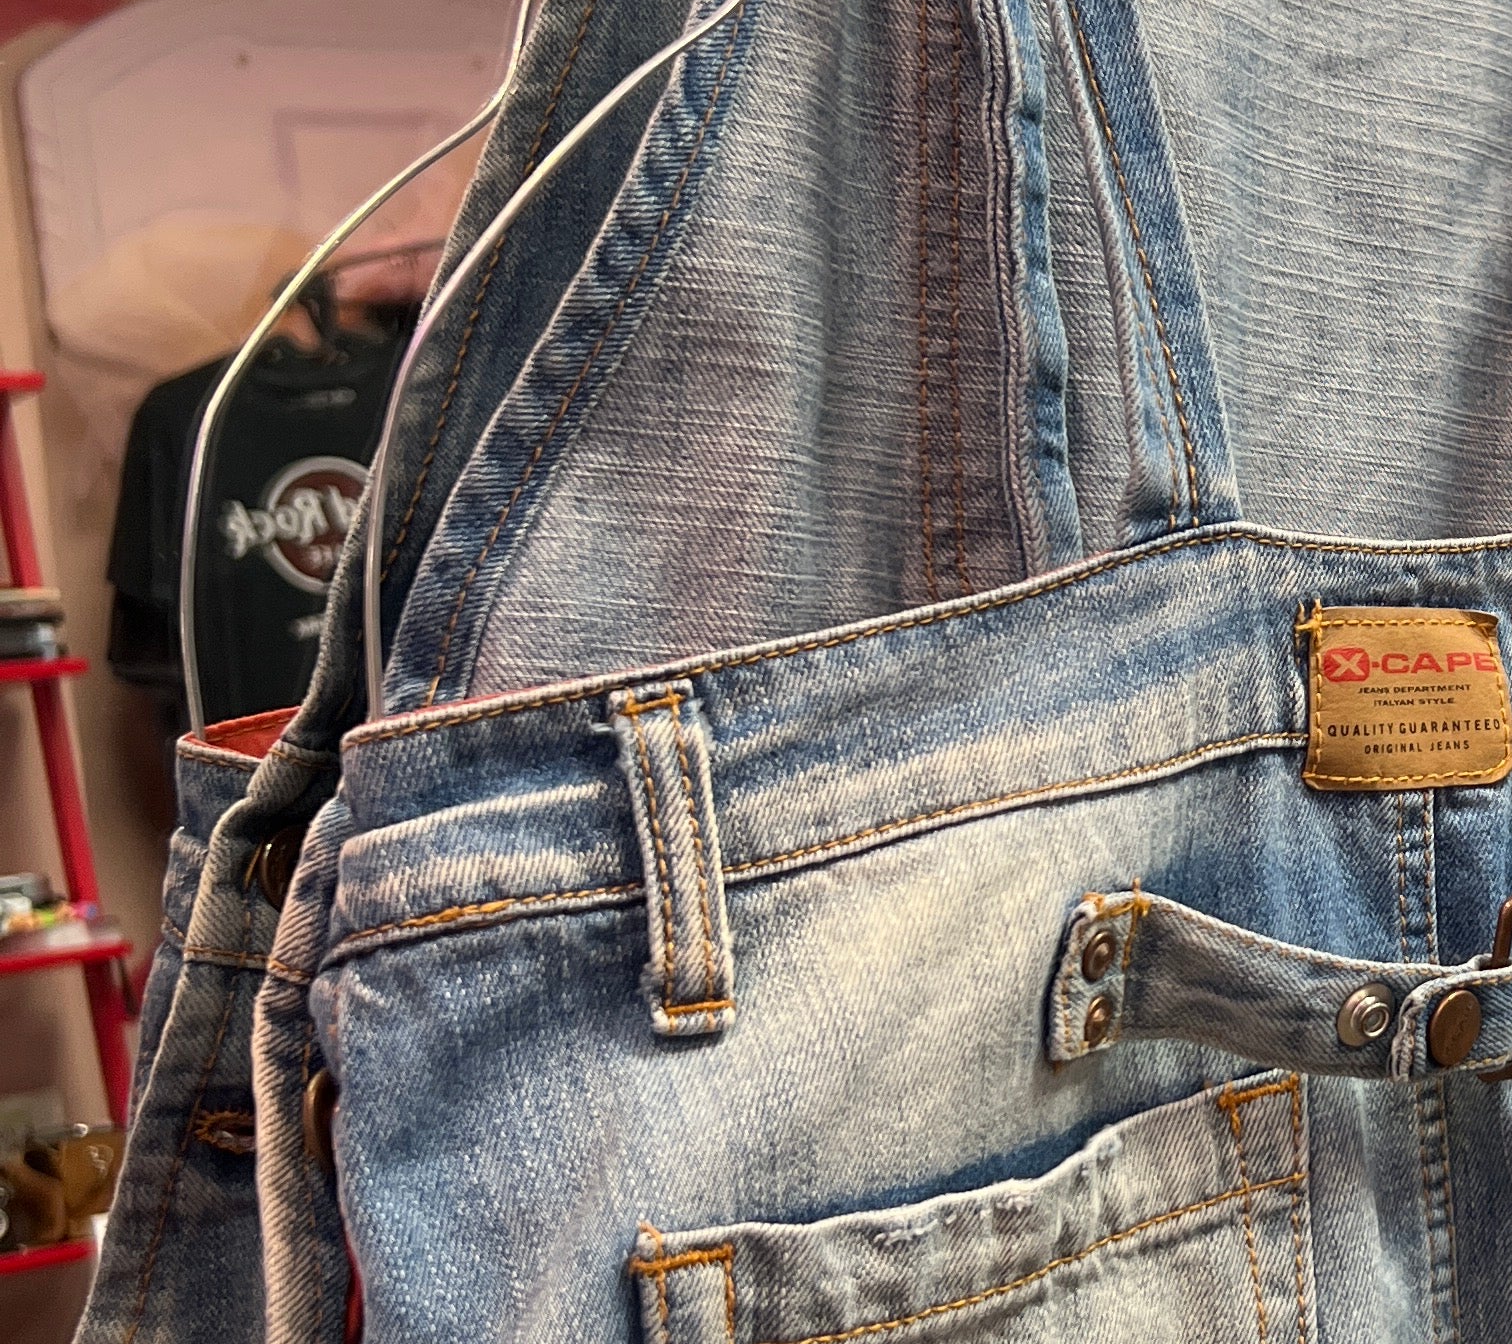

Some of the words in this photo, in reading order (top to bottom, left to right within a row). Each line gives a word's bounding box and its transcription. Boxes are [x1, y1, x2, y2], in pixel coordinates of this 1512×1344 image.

[1322, 646, 1498, 683] X-CAPE
[1358, 685, 1390, 694] JEANS
[1393, 683, 1471, 694] DEPARTMENT
[1418, 697, 1455, 706] STYLE
[1327, 722, 1394, 738] QUALITY
[1399, 718, 1501, 735] GUARANTEED
[1364, 742, 1423, 755] ORIGINAL
[1429, 739, 1470, 751] JEANS
